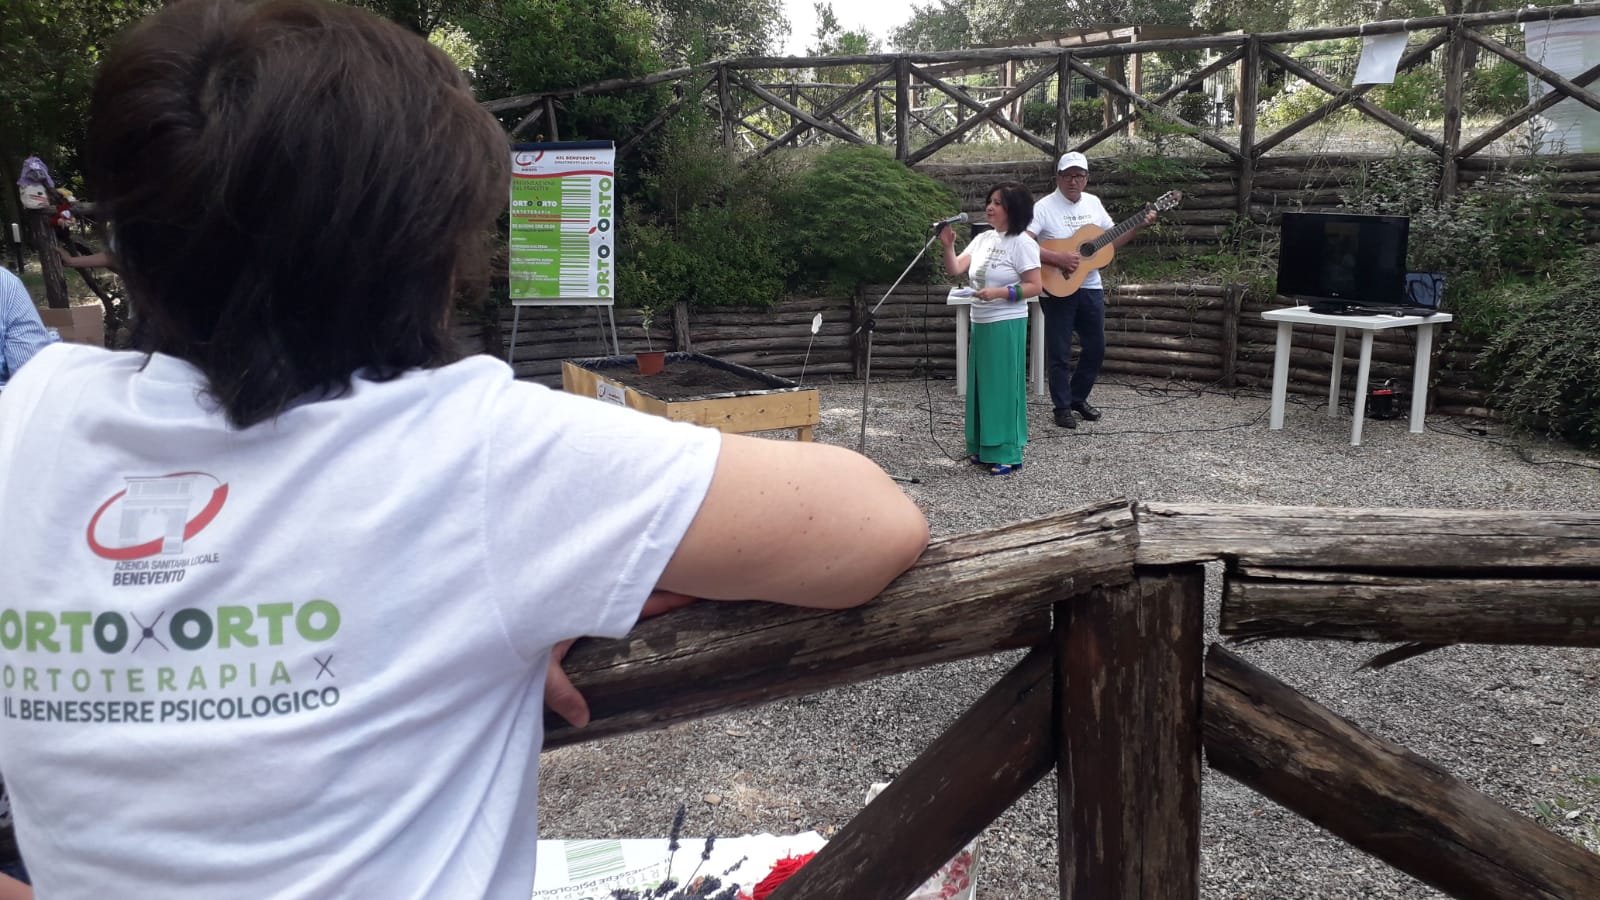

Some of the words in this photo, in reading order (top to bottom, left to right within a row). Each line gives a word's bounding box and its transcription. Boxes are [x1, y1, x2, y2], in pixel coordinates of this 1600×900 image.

[598, 177, 612, 232] ORTO
[597, 245, 610, 297] ORTO
[112, 569, 186, 587] BENEVENTO
[114, 559, 149, 571] AZIENDA
[151, 558, 191, 570] SANITARIA
[191, 552, 220, 567] LOCALE
[0, 608, 128, 654] ORTO
[169, 600, 341, 651] ORTO
[3, 661, 292, 693] ORTOTERAPIA
[4, 696, 17, 719] IL
[20, 699, 155, 723] BENESSERE
[160, 686, 341, 723] PSICOLOGICO
[532, 880, 597, 897] PSICOLOGIC
